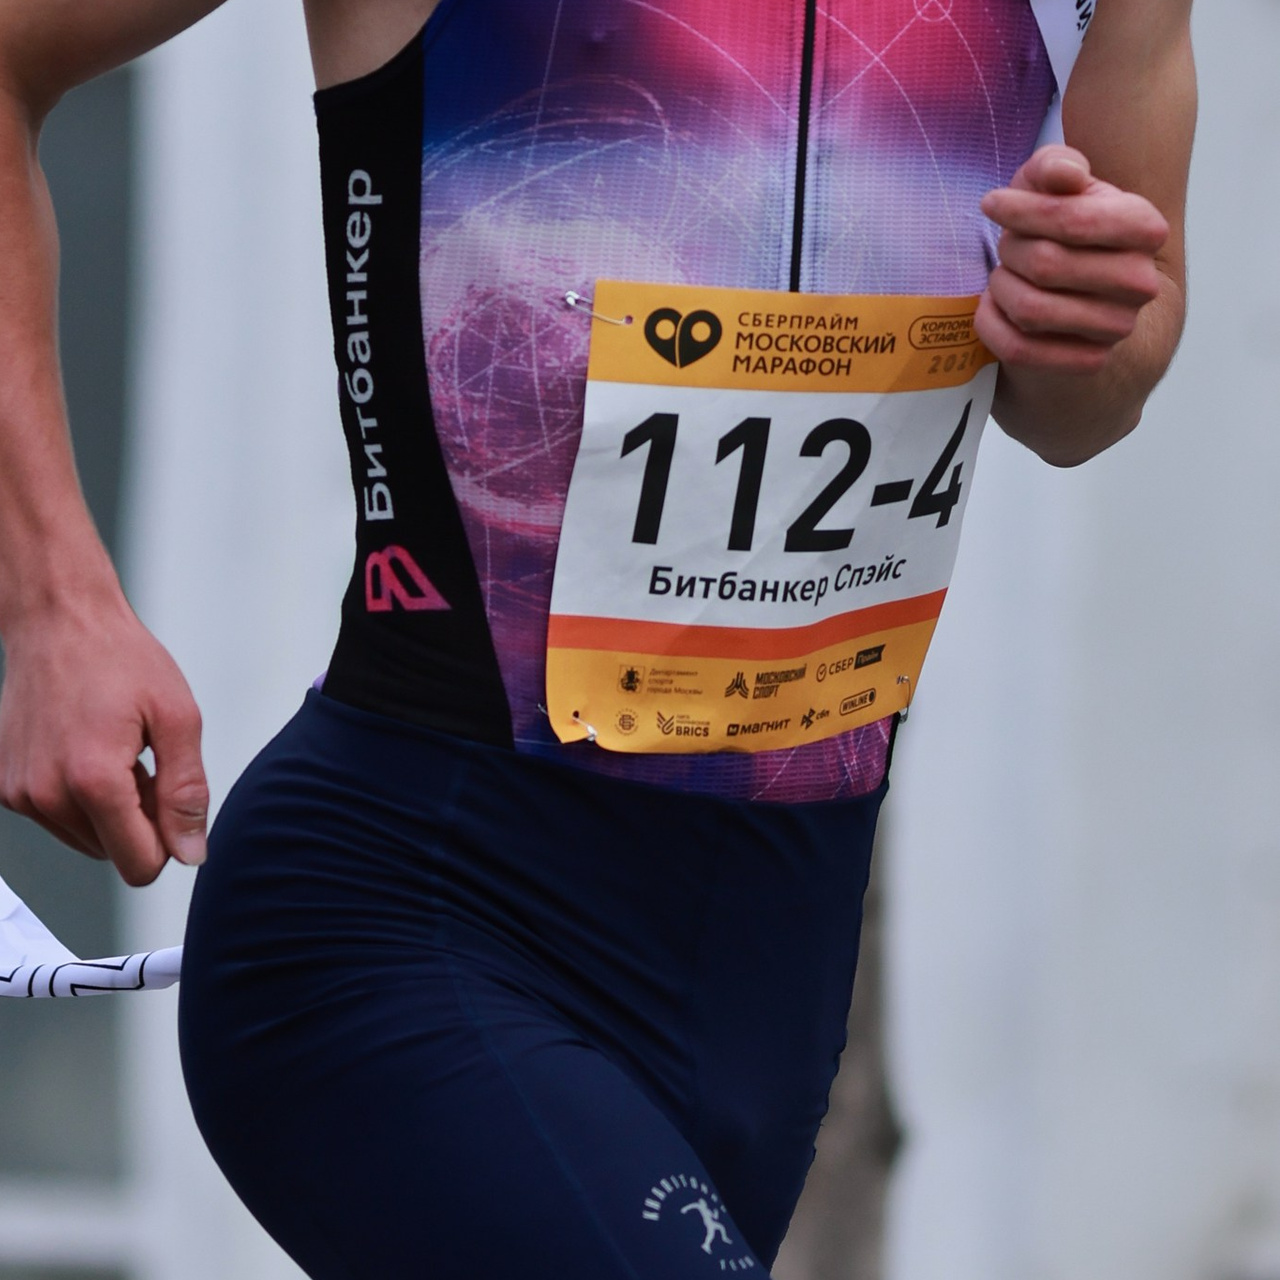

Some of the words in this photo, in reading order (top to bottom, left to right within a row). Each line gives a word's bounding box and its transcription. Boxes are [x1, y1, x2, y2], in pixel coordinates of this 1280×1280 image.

[737, 311, 859, 331] СБЕРПРАЙМ
[345, 168, 395, 521] Битбанкер
[734, 331, 897, 355] МОСКОВСКИЙ
[731, 354, 853, 377] МАРАФОН
[619, 397, 974, 554] 112-4
[647, 564, 829, 606] Битбанкер
[833, 554, 908, 594] Спэйс
[828, 656, 855, 675] СБЕР
[675, 724, 710, 738] BRICS
